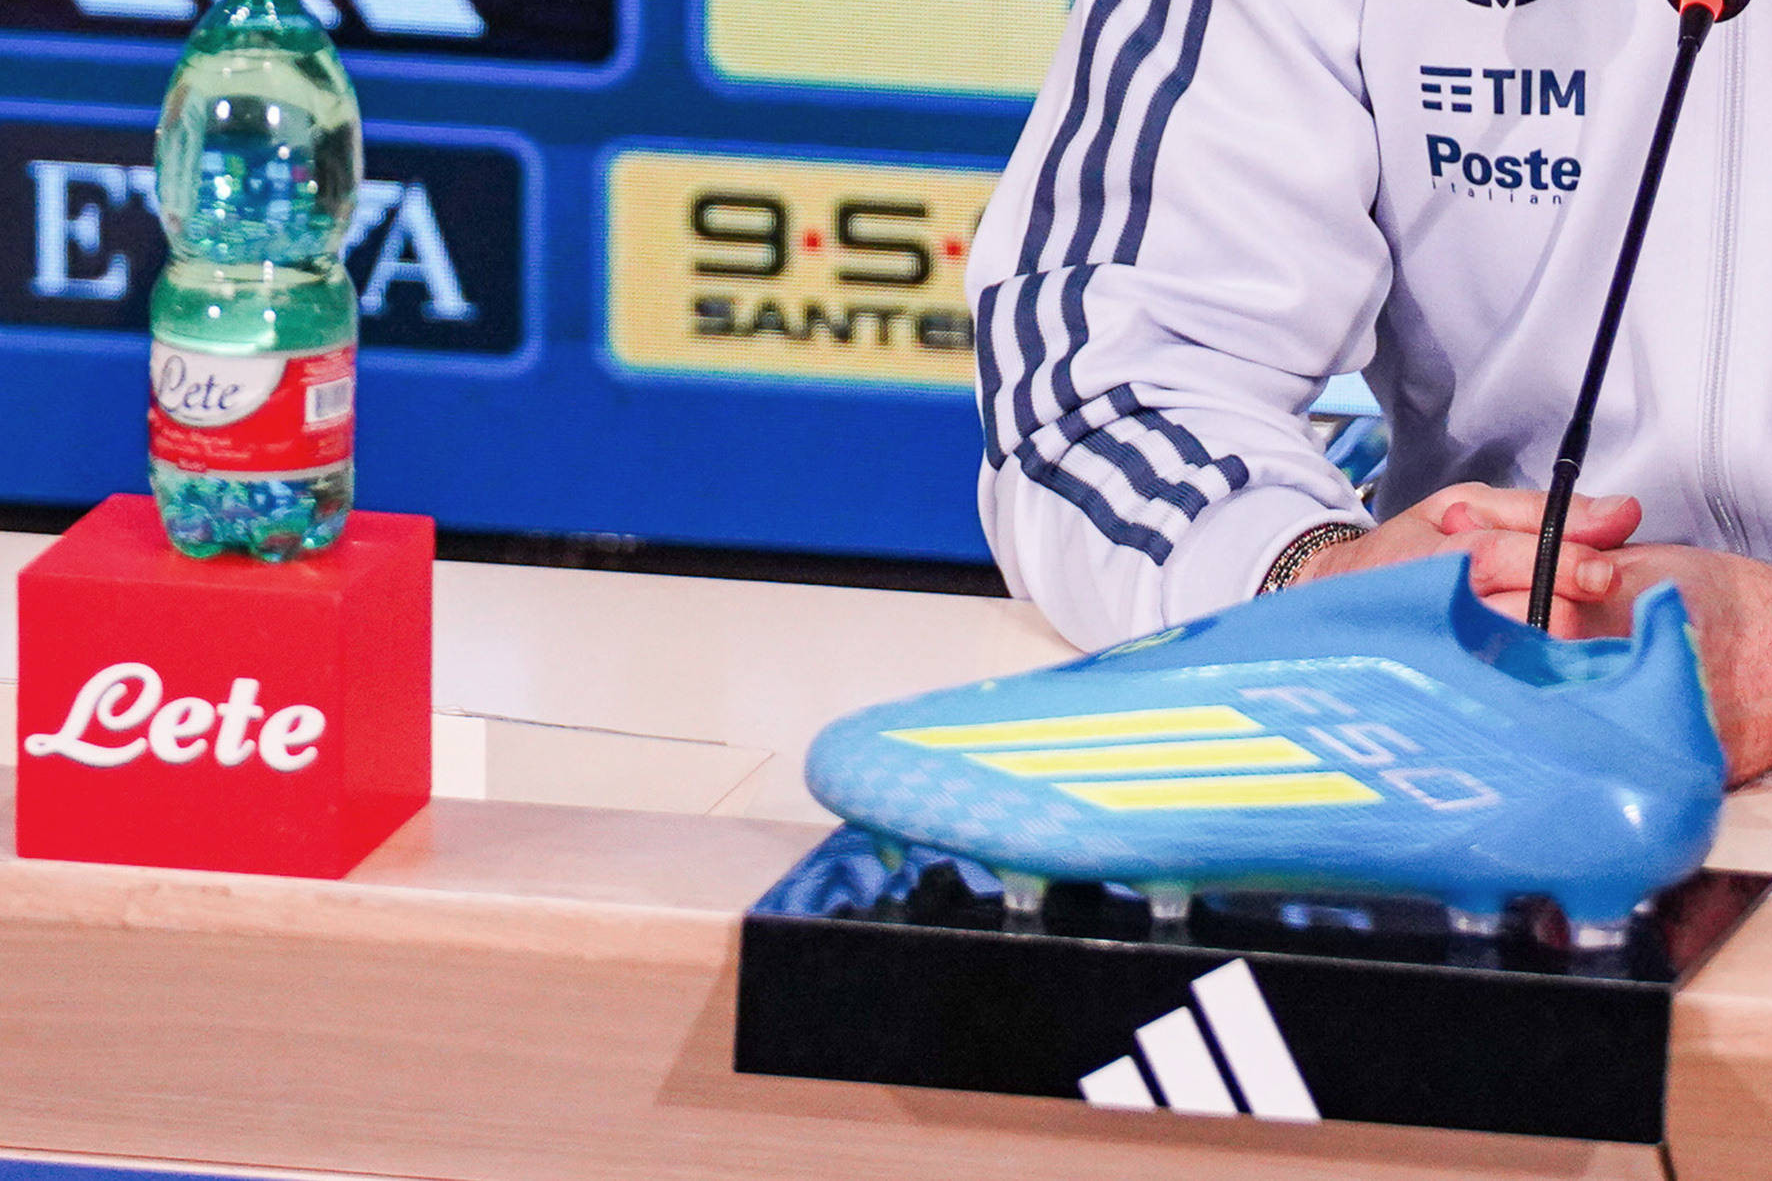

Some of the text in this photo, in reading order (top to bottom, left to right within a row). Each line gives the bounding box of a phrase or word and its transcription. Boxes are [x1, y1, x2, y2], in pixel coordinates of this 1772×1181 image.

[1483, 68, 1586, 116] TIM
[1426, 134, 1582, 192] Poste
[158, 354, 240, 413] Lete
[24, 662, 327, 772] Lete
